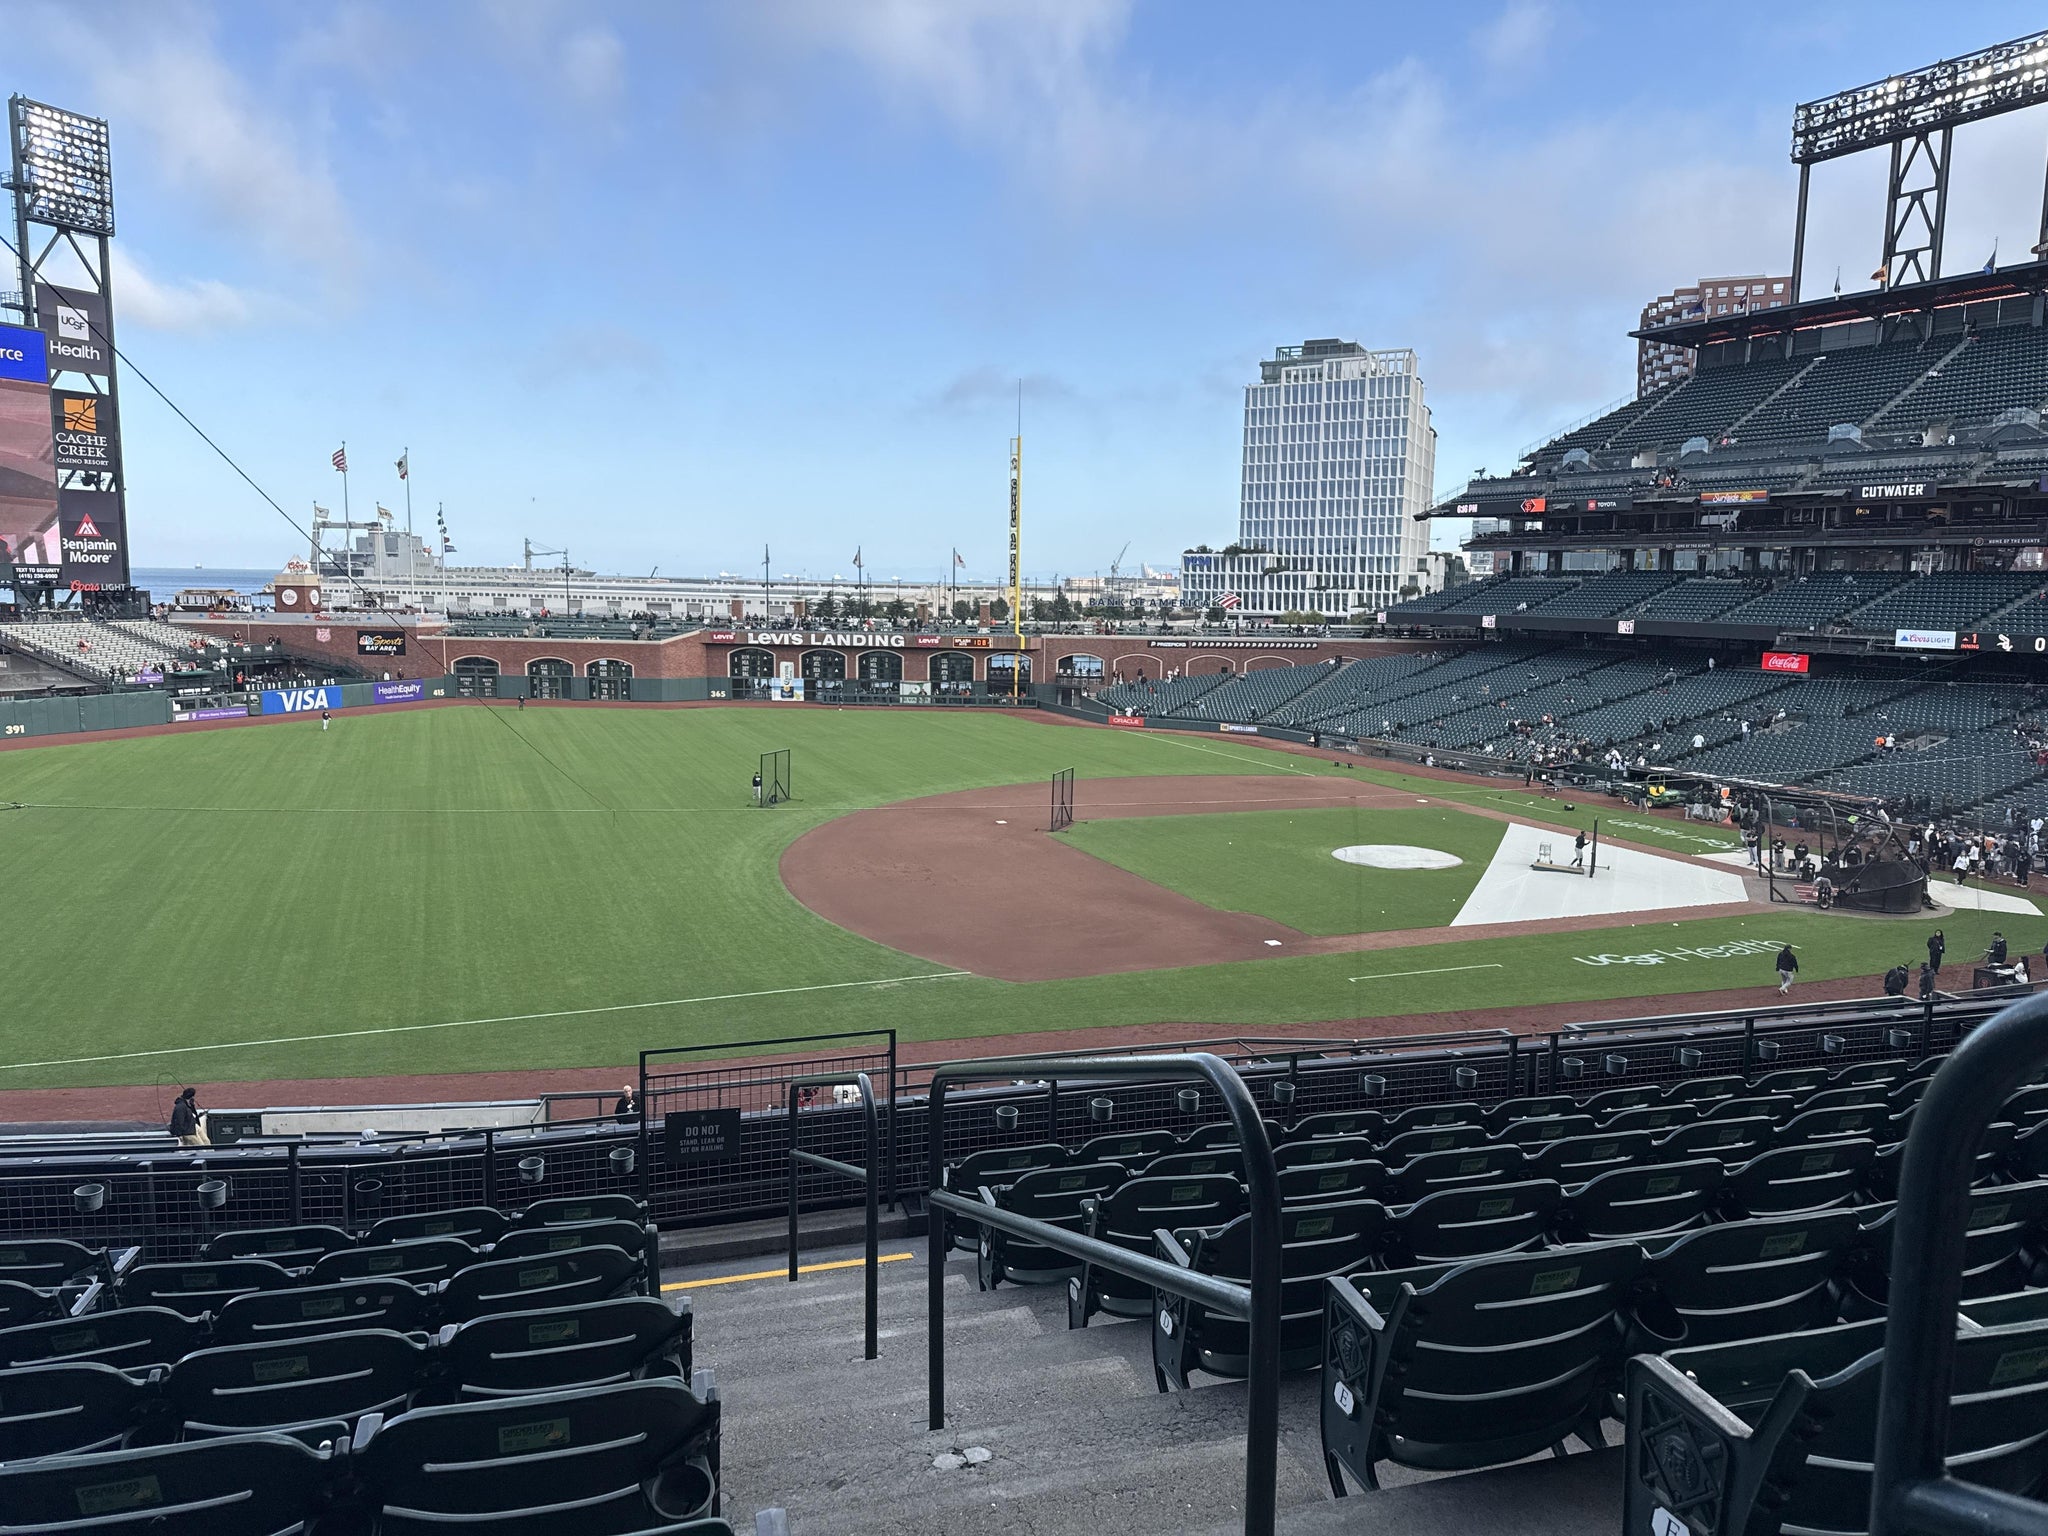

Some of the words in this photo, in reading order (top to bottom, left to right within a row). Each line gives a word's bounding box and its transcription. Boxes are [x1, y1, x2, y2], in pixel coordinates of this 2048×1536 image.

[61, 315, 86, 331] UCSF
[50, 340, 100, 361] Health
[56, 432, 107, 447] CACHE
[57, 444, 107, 458] CREEK
[57, 457, 82, 465] CASINO
[1861, 484, 1924, 498] CUTWATER
[62, 538, 117, 552] Benjamin
[70, 551, 110, 563] Moore
[70, 580, 100, 592] Coors
[101, 583, 126, 592] LIGHT
[1089, 598, 1124, 607] BANK
[1130, 598, 1146, 607] OF
[1149, 598, 1210, 607] AMERICA
[373, 635, 404, 647] Sports
[810, 634, 905, 647] LANDING
[1971, 633, 1978, 643] 1
[2034, 637, 2046, 652] 0
[322, 678, 335, 686] 415
[378, 684, 421, 696] HealthEquity
[433, 688, 445, 697] 415
[710, 690, 726, 698] 365
[277, 688, 328, 713] VISA
[5, 724, 25, 735] 391
[1573, 952, 1667, 966] UCSF
[1653, 939, 1800, 961] Health
[685, 1126, 699, 1137] DO
[701, 1124, 720, 1136] NOT
[679, 1138, 699, 1147] STAND,
[701, 1136, 715, 1145] LEAN
[701, 1144, 724, 1152] RAILING
[1163, 1314, 1169, 1327] D
[1340, 1387, 1348, 1407] E
